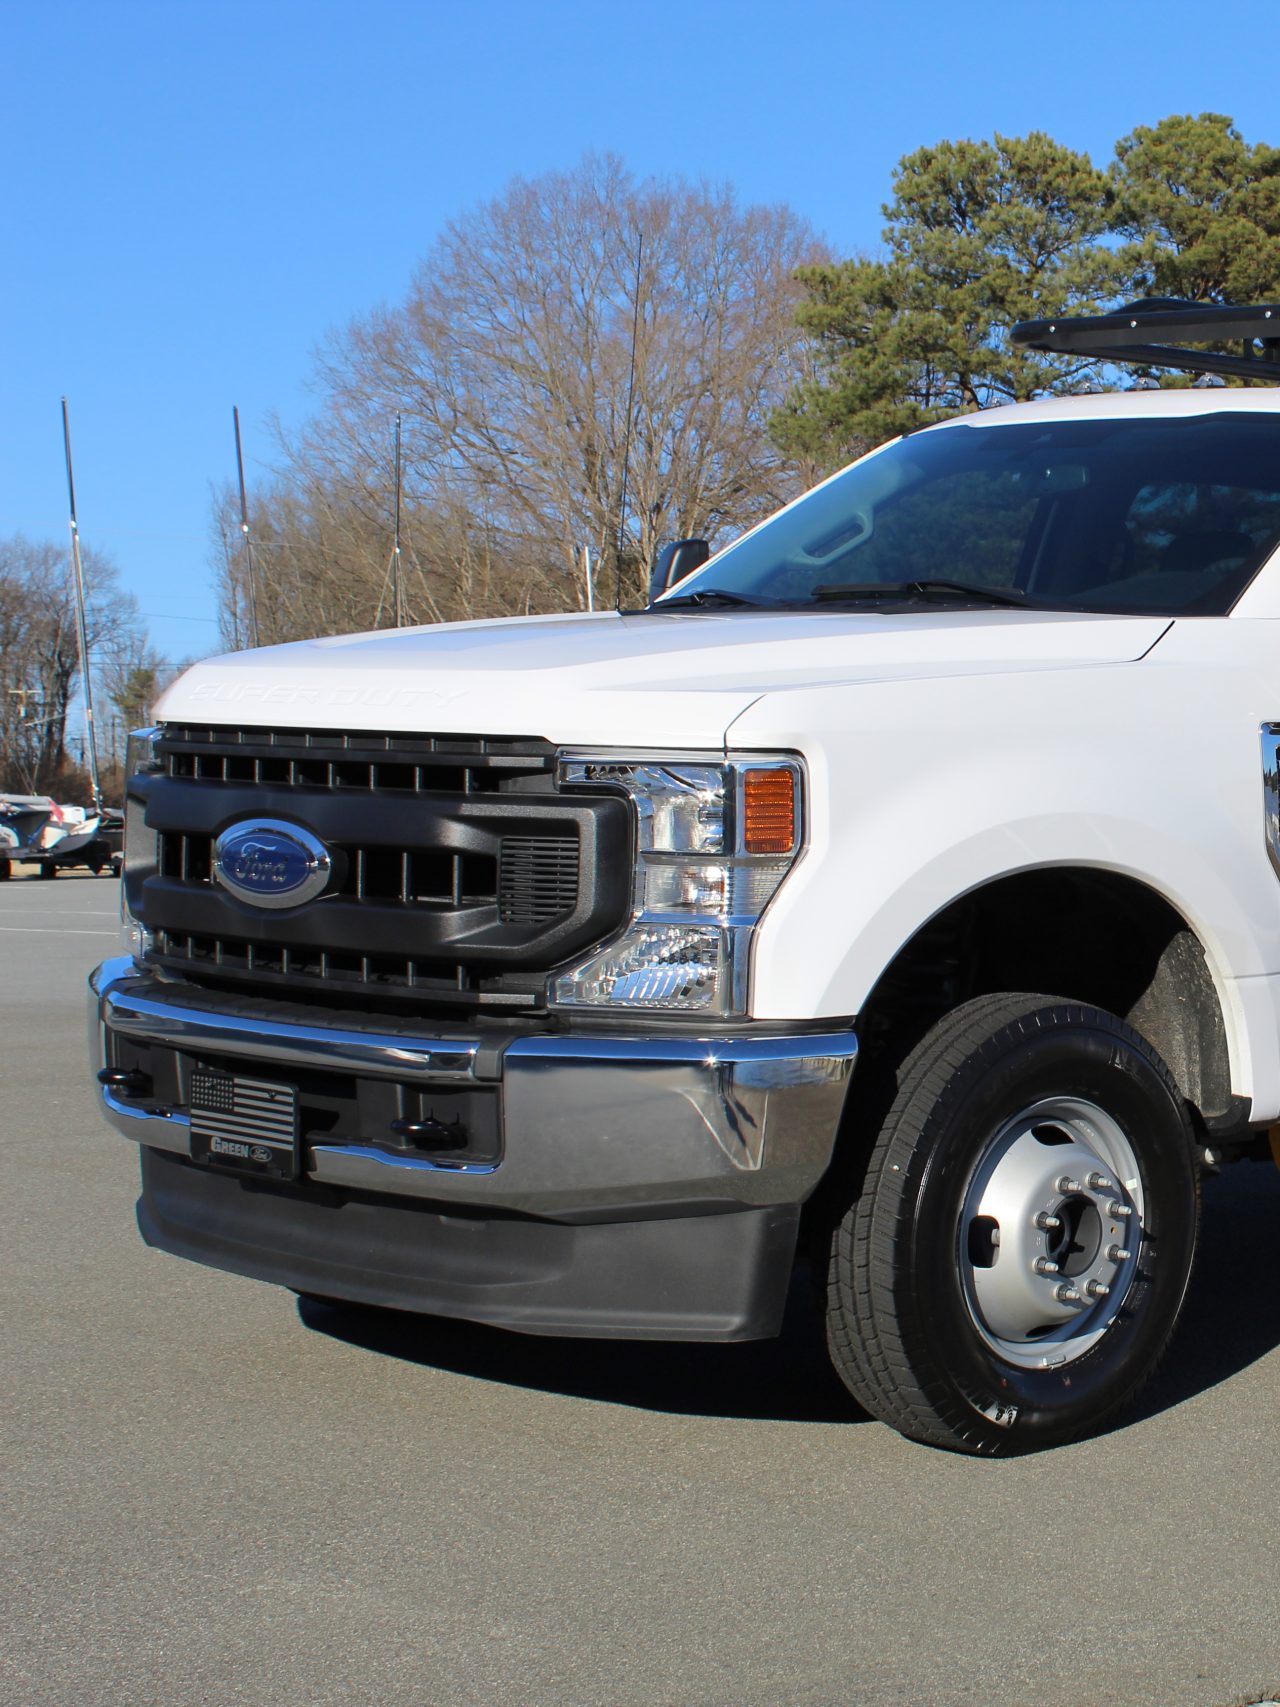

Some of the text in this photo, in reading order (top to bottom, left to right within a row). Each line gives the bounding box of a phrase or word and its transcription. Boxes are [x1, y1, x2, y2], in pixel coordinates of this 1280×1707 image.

[188, 681, 472, 709] SUPER DUTY
[235, 842, 286, 882] Ford
[210, 1136, 249, 1158] GREEN
